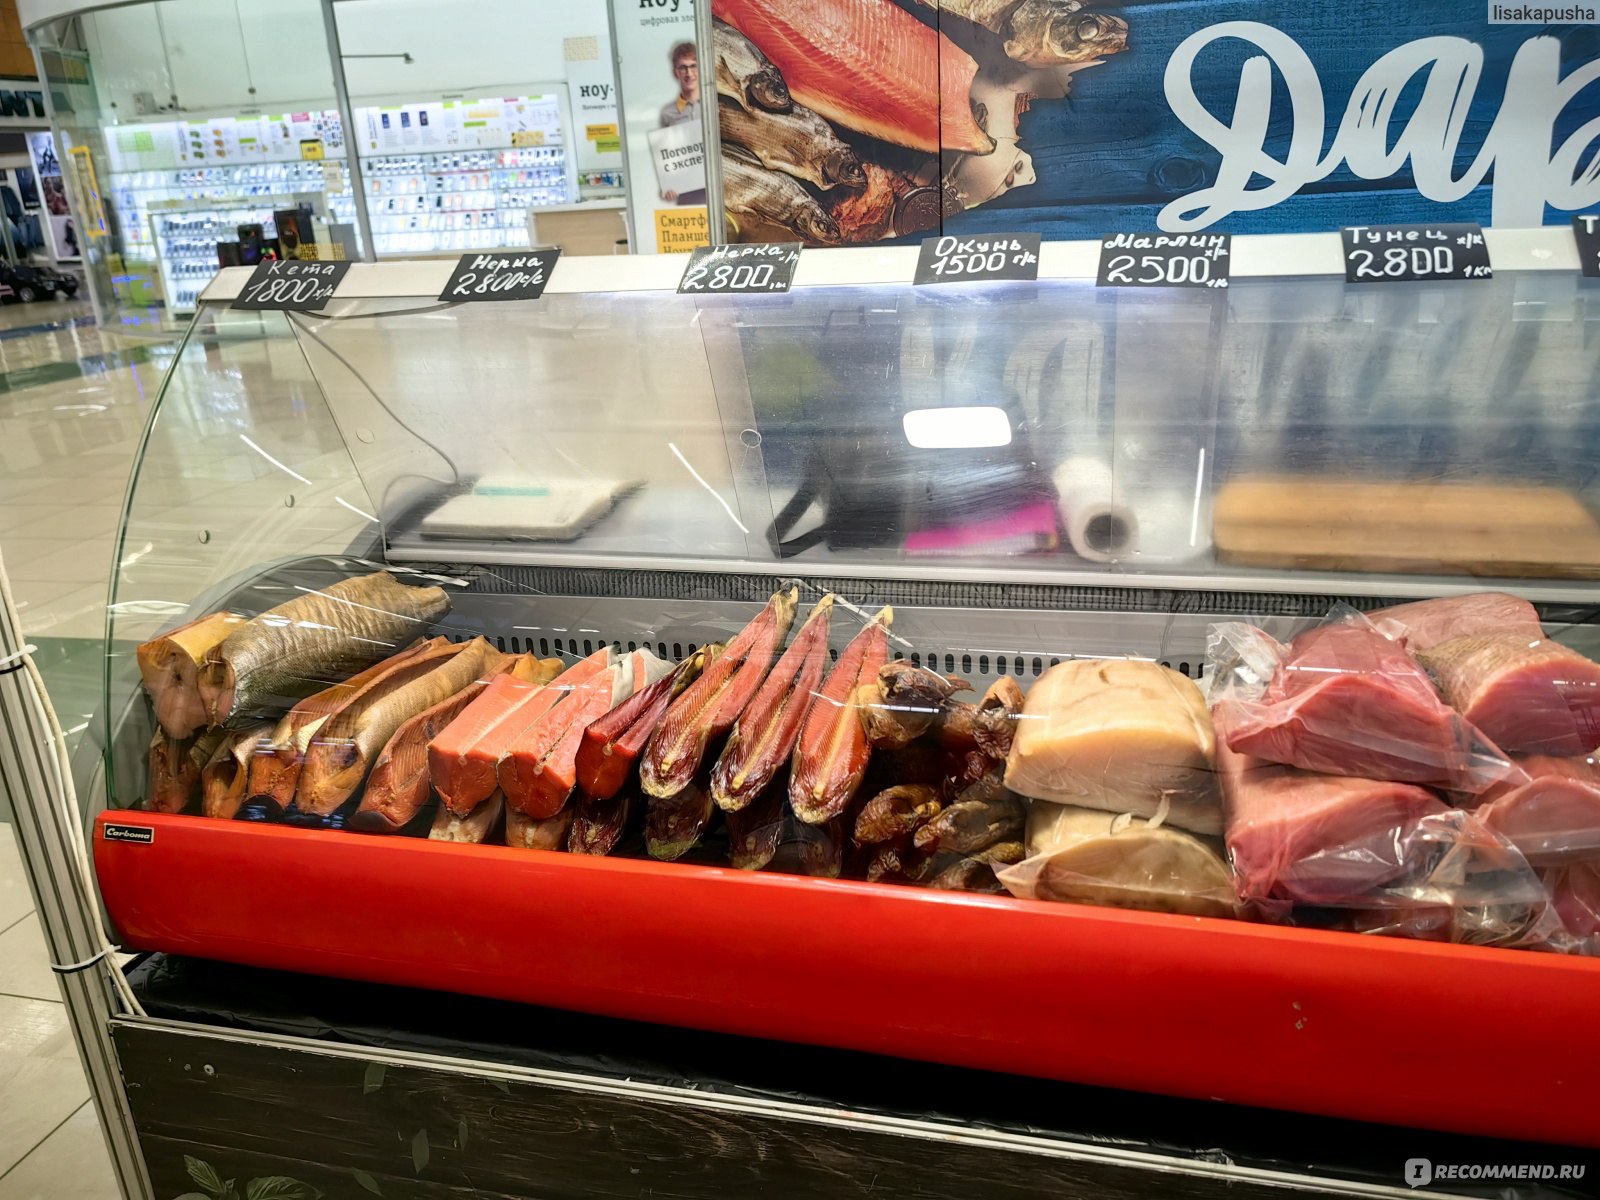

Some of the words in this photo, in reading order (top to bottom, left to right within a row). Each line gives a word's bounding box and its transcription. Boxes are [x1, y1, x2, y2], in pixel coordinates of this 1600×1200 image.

[663, 162, 670, 173] с
[672, 155, 704, 171] экспе
[660, 213, 708, 229] Смартф
[1104, 233, 1225, 249] Марлин
[1345, 227, 1448, 244] Тунец
[712, 244, 784, 259] Нерка
[935, 236, 1022, 257] Окунь
[267, 260, 335, 276] Кета
[470, 254, 544, 274] Нерка
[930, 252, 1011, 276] 1500
[1107, 255, 1210, 284] 2500
[1348, 245, 1454, 278] 2800
[452, 271, 524, 295] 2800
[682, 264, 774, 290] 2800
[245, 277, 320, 303] 1800
